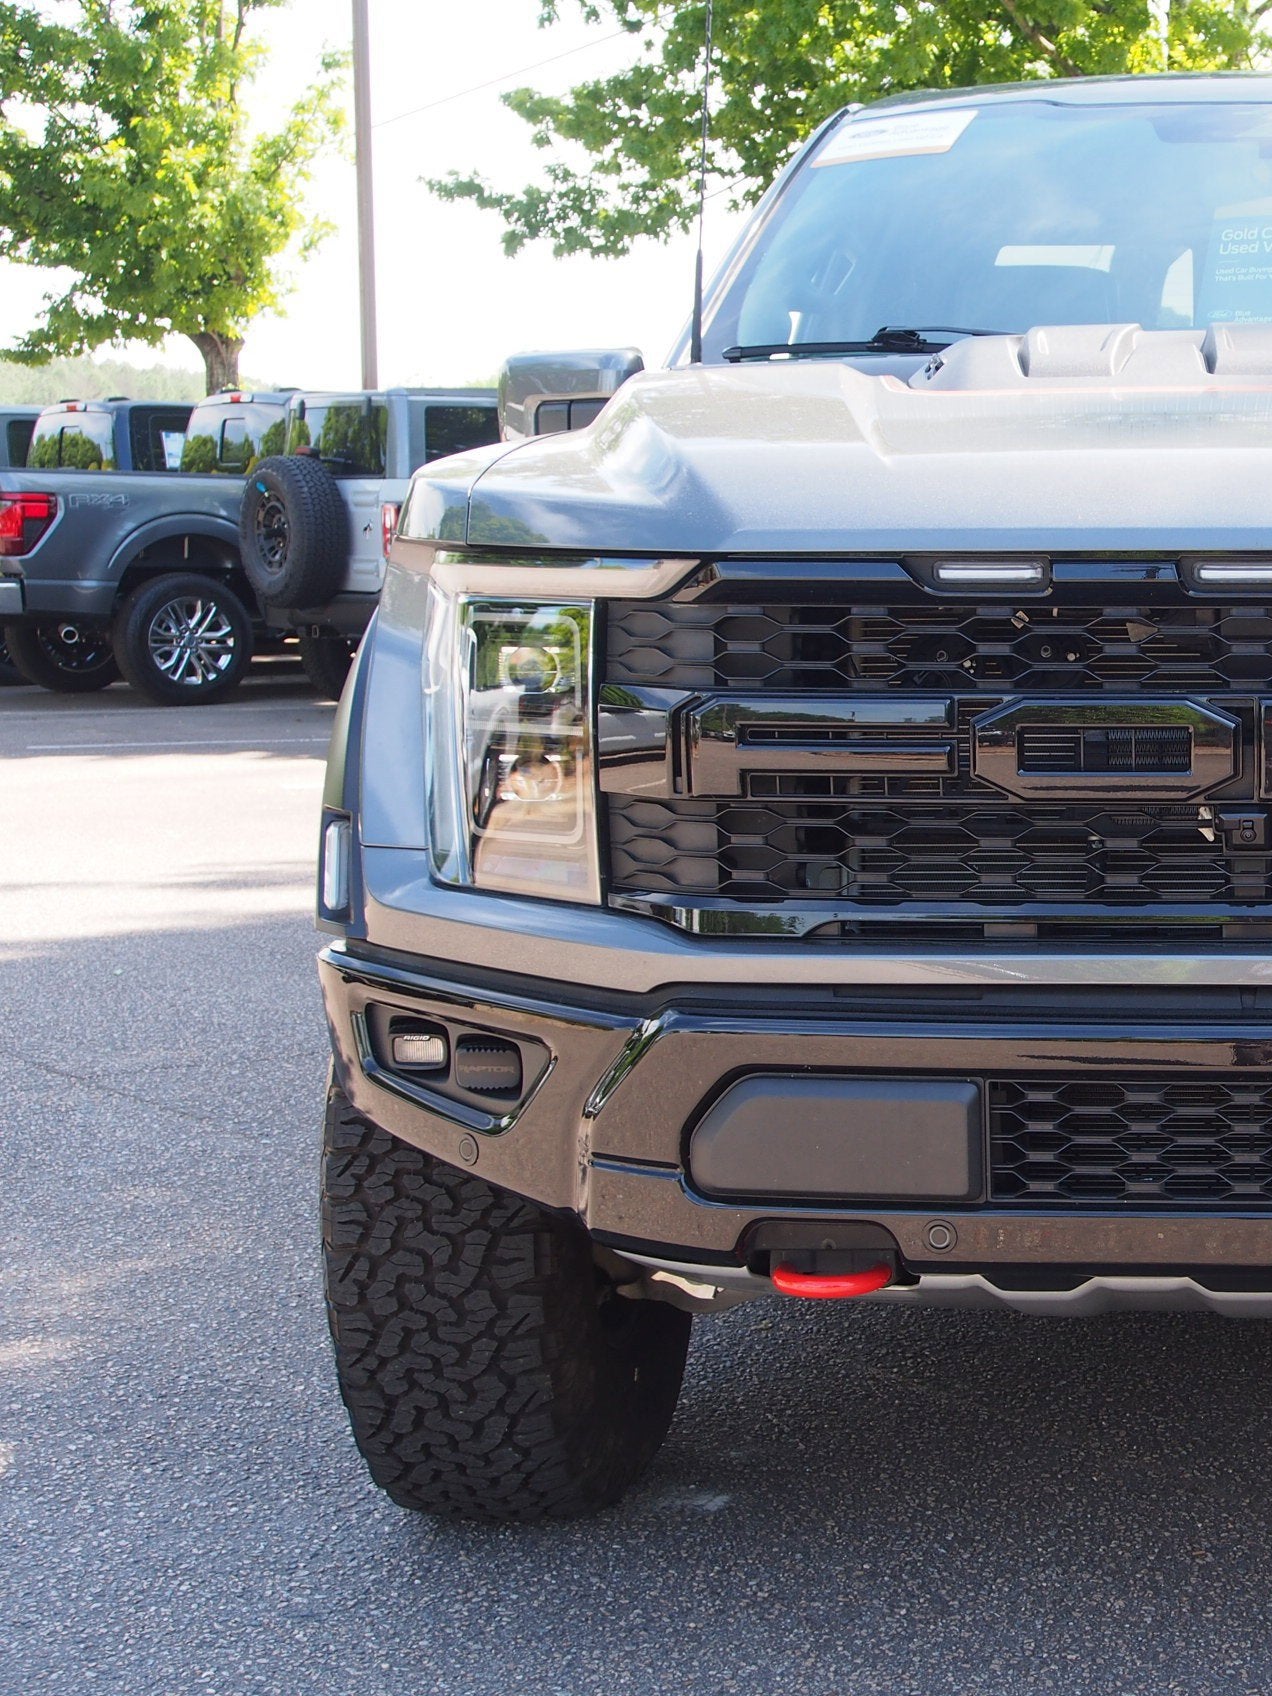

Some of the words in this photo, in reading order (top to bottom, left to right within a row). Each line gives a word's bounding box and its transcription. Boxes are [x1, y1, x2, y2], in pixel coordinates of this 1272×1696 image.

[1220, 227, 1258, 241] Gold
[1218, 240, 1260, 255] Used
[458, 1064, 516, 1074] RAPTOR
